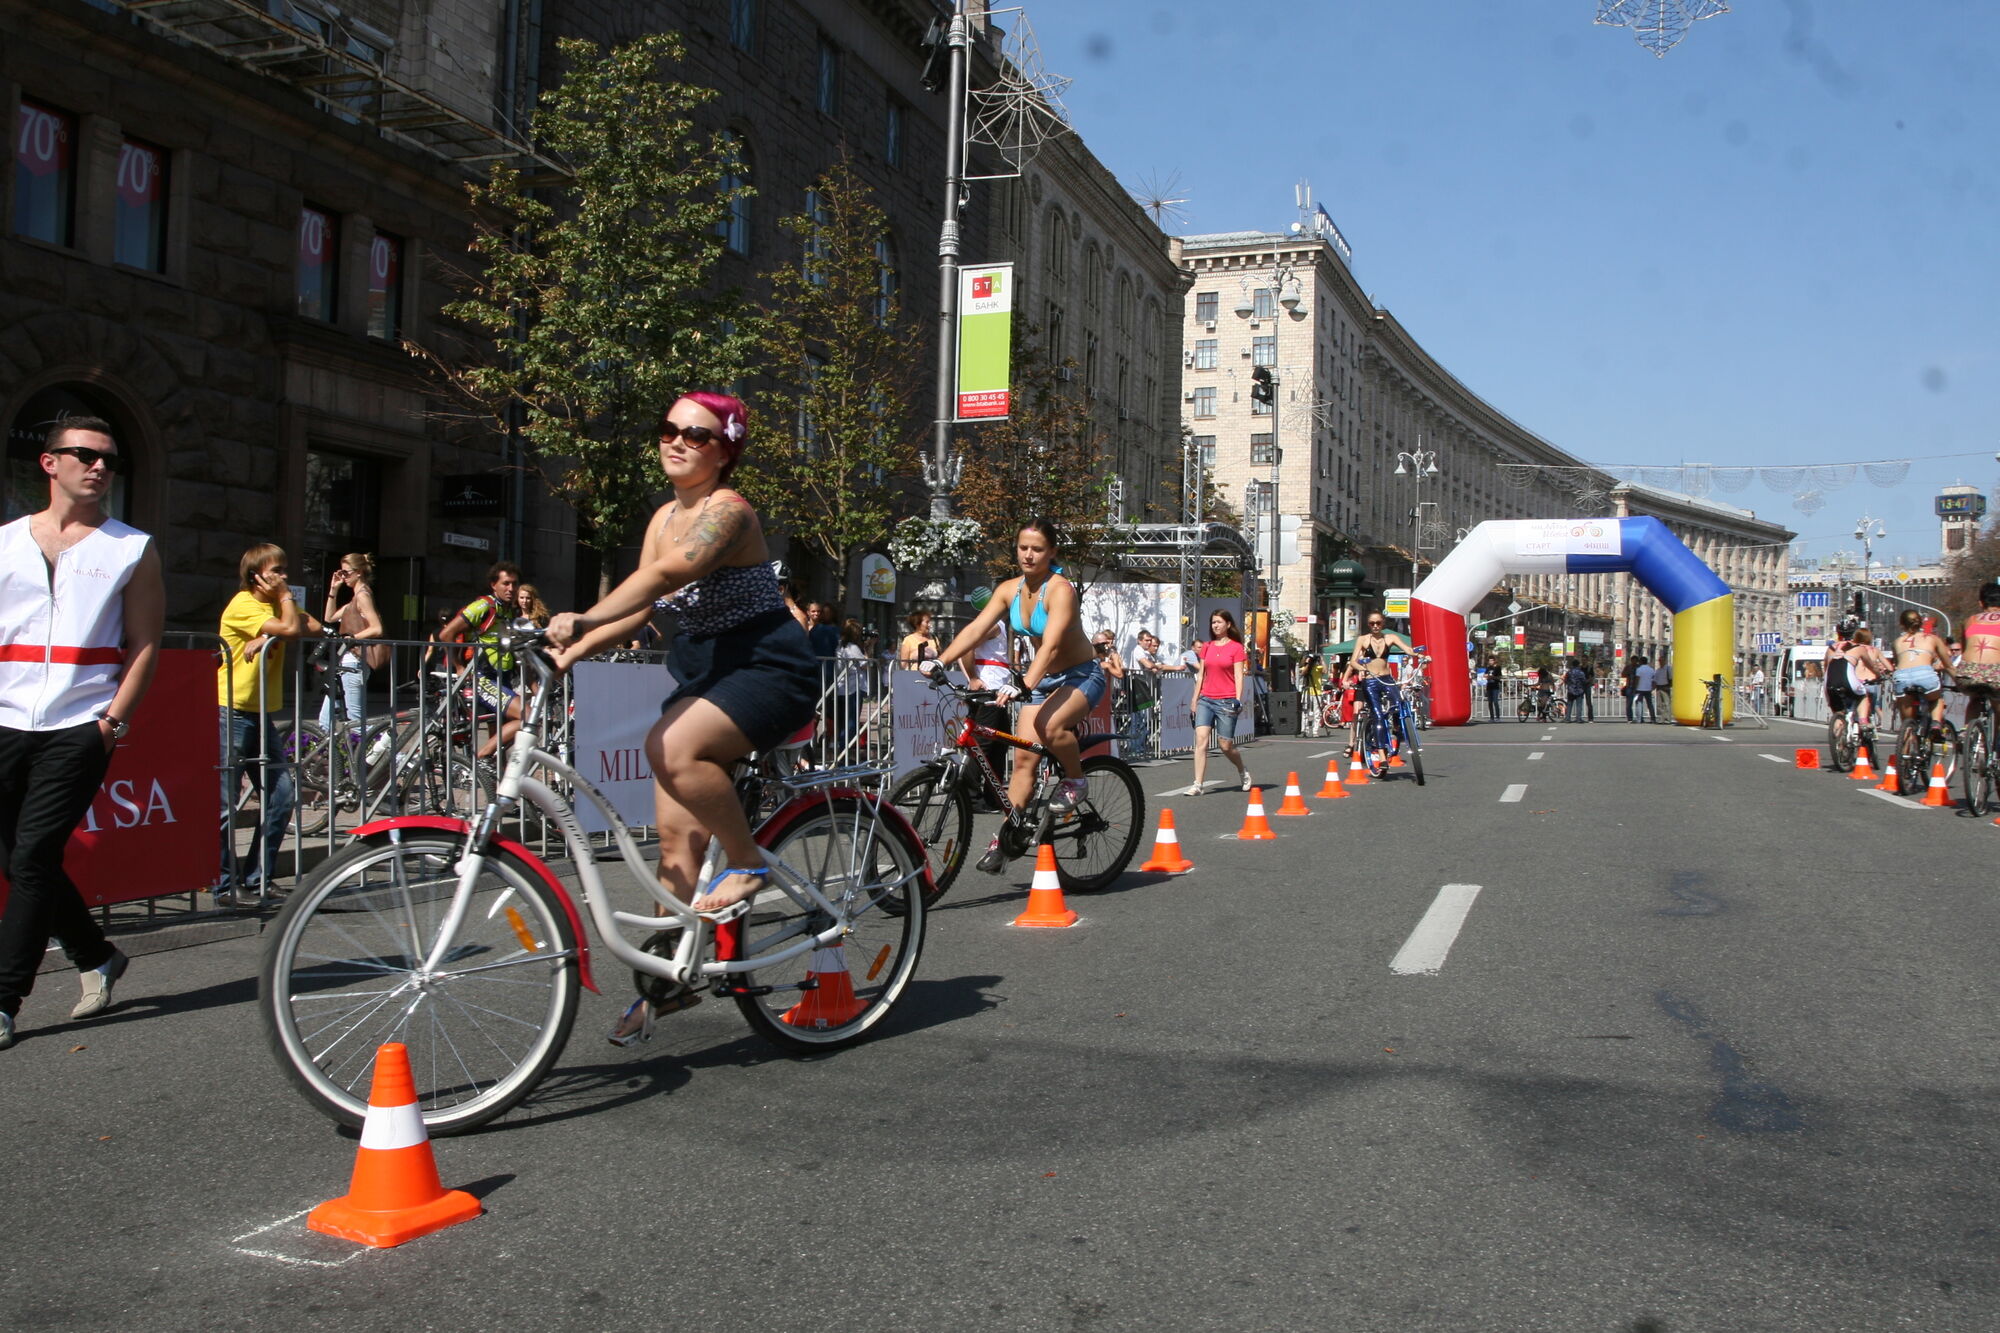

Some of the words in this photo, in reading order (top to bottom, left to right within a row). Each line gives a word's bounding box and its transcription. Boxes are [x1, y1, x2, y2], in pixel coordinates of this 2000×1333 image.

[19, 104, 67, 161] 70%
[117, 143, 160, 193] 70%
[973, 280, 1001, 292] БТА
[975, 301, 1000, 310] БАНК
[10, 428, 46, 441] GRAN
[1526, 542, 1552, 550] СТАРТ
[898, 705, 942, 732] MILAVITSA
[599, 748, 653, 783] MIL
[971, 745, 1013, 809] FORWARD
